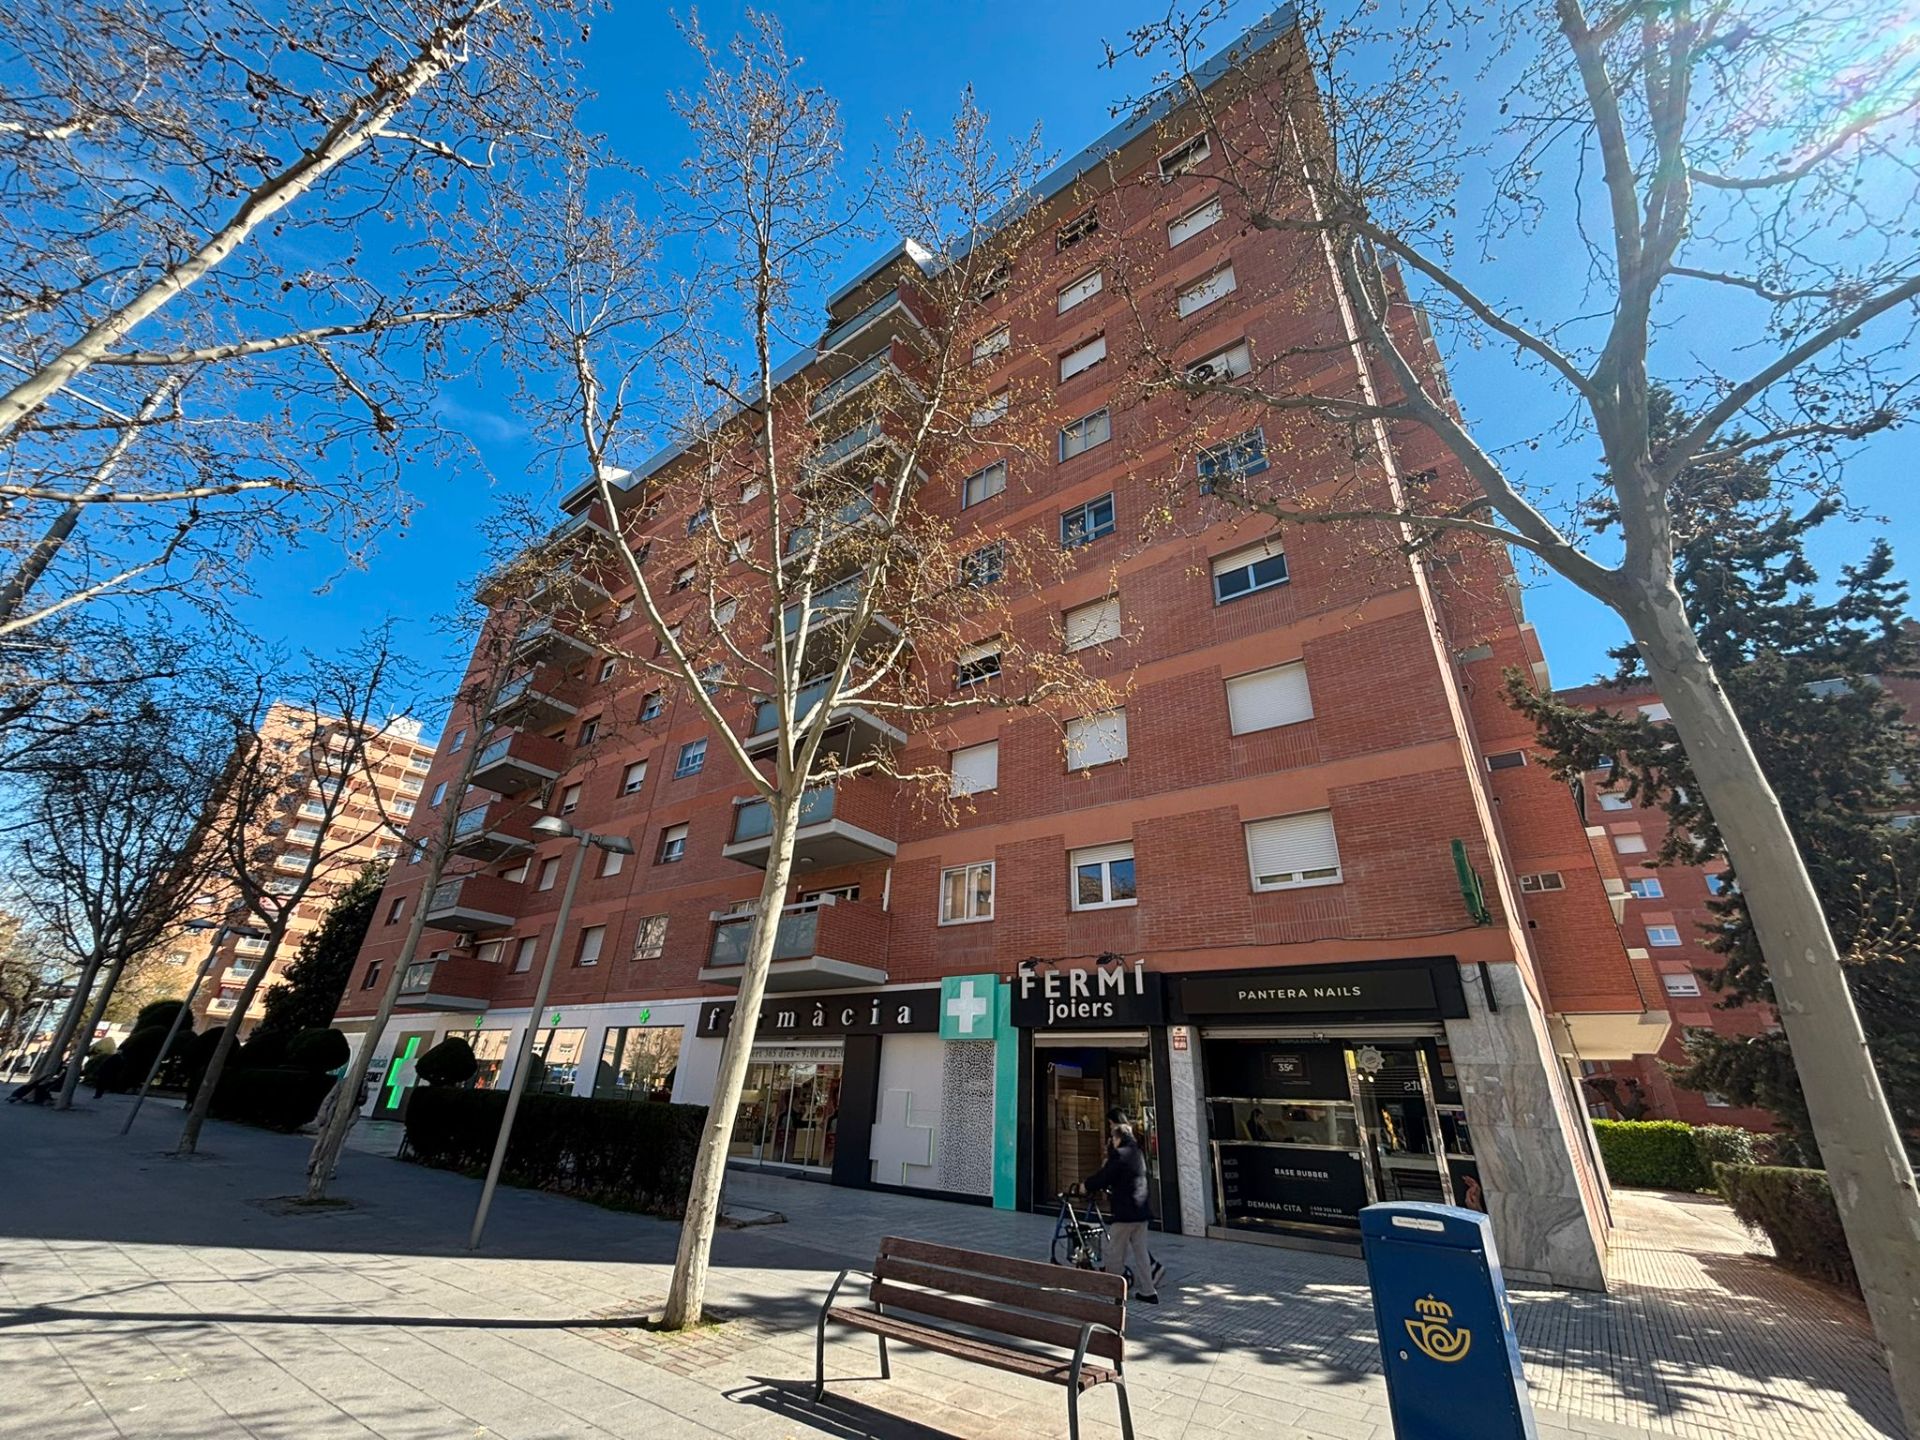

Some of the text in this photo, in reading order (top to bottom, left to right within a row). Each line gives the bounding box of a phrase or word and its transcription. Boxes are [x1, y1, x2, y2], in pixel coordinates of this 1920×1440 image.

[1238, 986, 1361, 1001] PANTERA NAILS
[707, 999, 912, 1031] fmàcia
[1047, 998, 1114, 1025] joiers
[1274, 1168, 1329, 1179] BASE RUBBER
[1247, 1200, 1282, 1211] DEMANA
[1283, 1204, 1302, 1213] CITA
